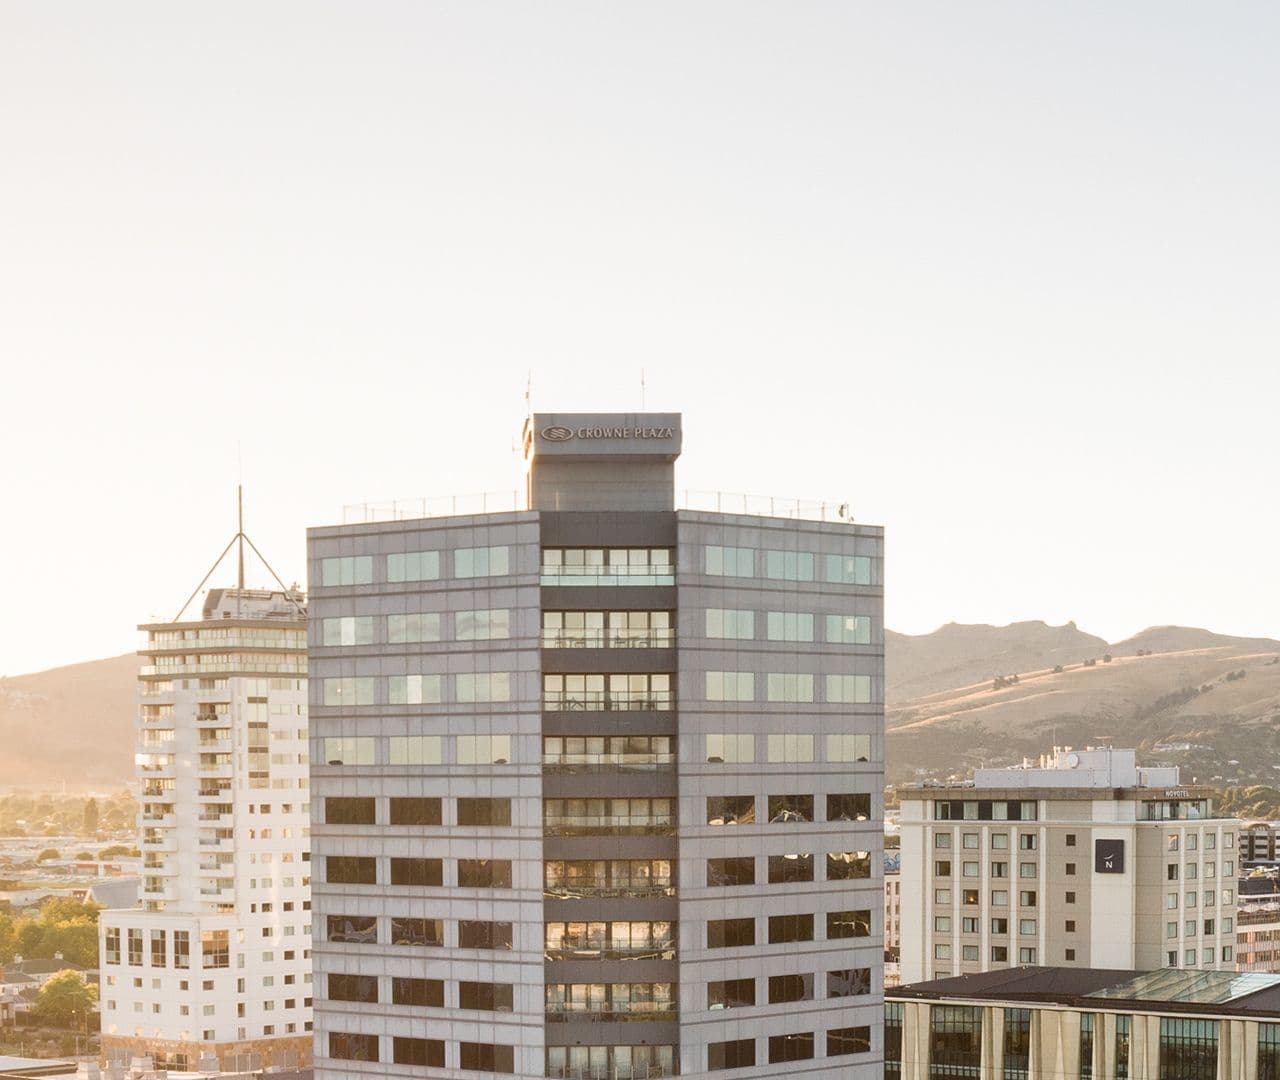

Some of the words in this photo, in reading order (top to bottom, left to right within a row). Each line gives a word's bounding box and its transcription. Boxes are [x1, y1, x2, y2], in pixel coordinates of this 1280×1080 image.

[577, 427, 629, 439] CROWNE
[634, 427, 673, 439] PLAZA
[1165, 790, 1190, 798] NOVOTEL
[1105, 861, 1113, 869] N
